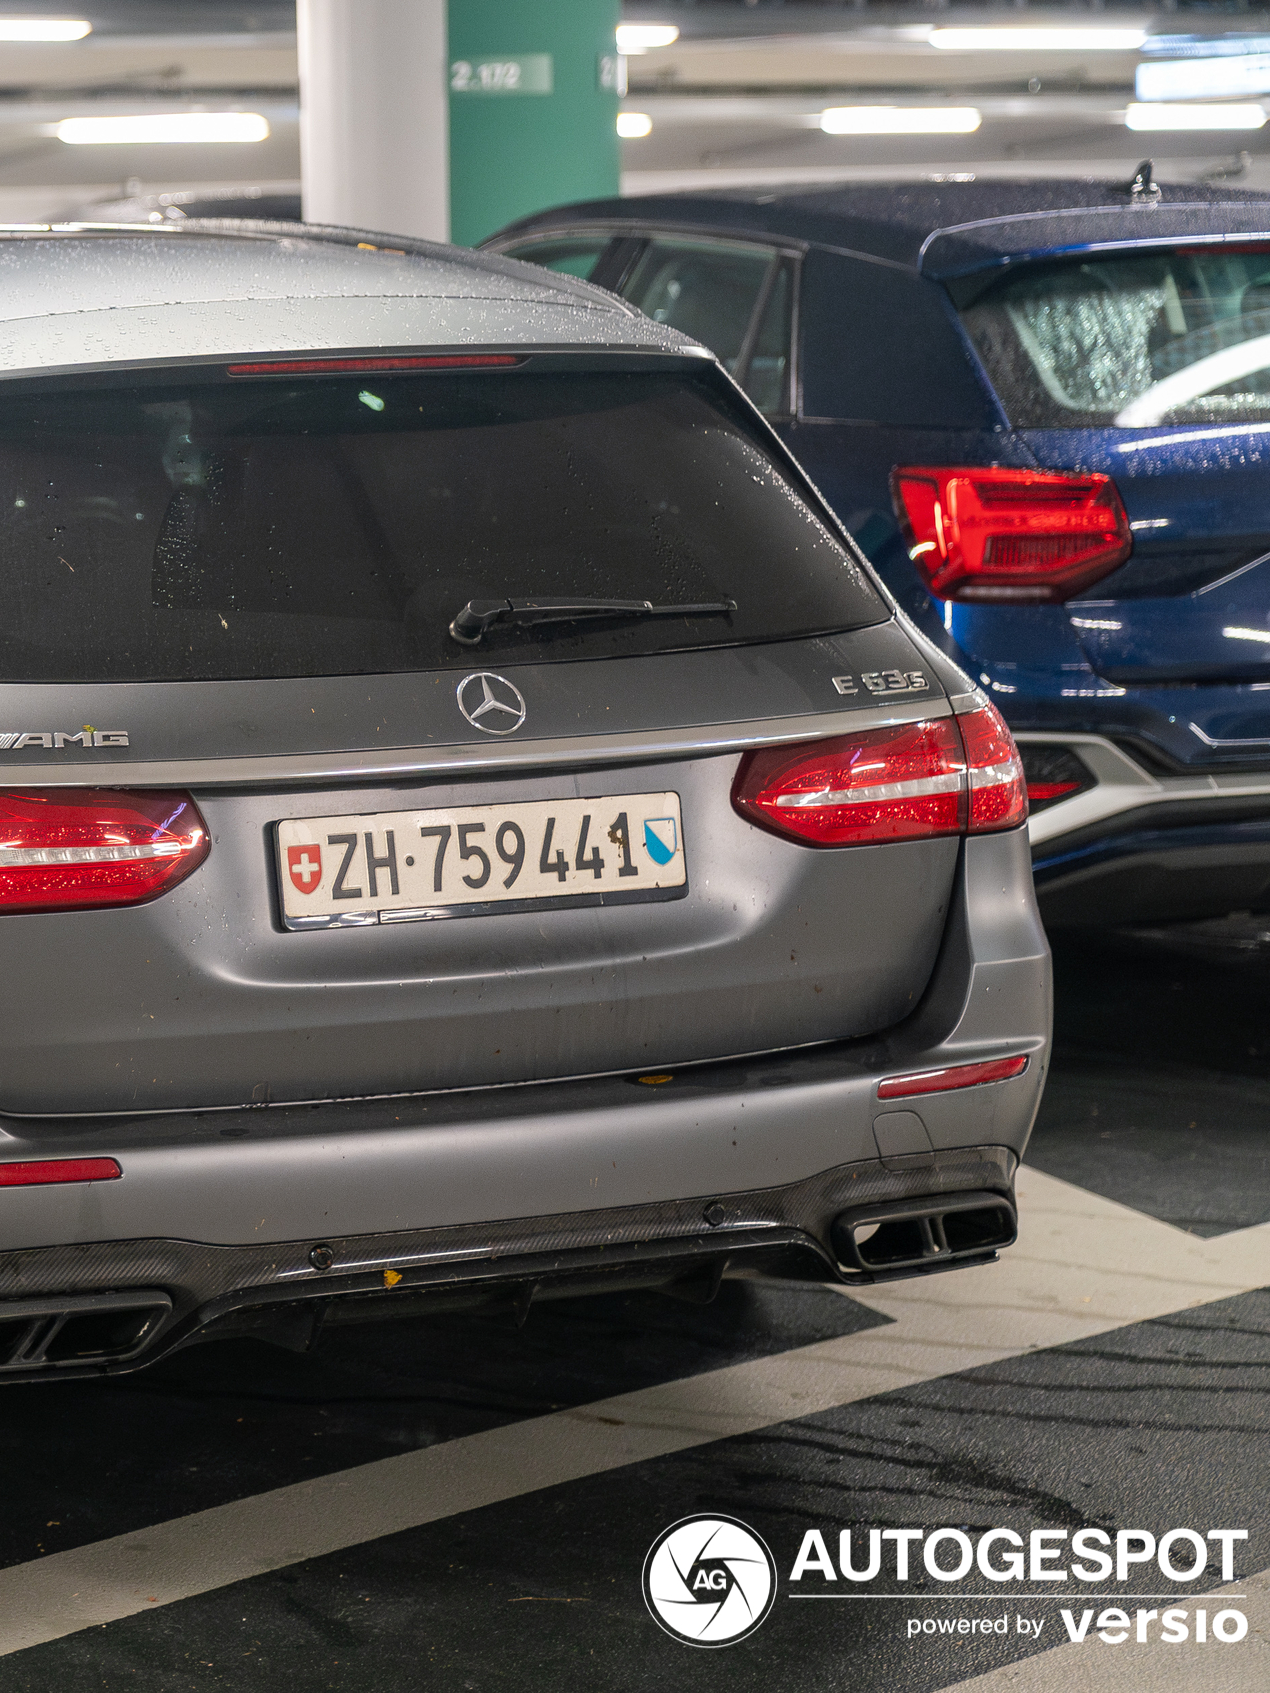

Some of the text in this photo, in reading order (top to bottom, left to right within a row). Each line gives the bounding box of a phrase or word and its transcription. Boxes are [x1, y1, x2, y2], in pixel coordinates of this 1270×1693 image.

[450, 60, 521, 92] 2.172
[831, 675, 859, 695] E
[12, 730, 130, 750] AMG
